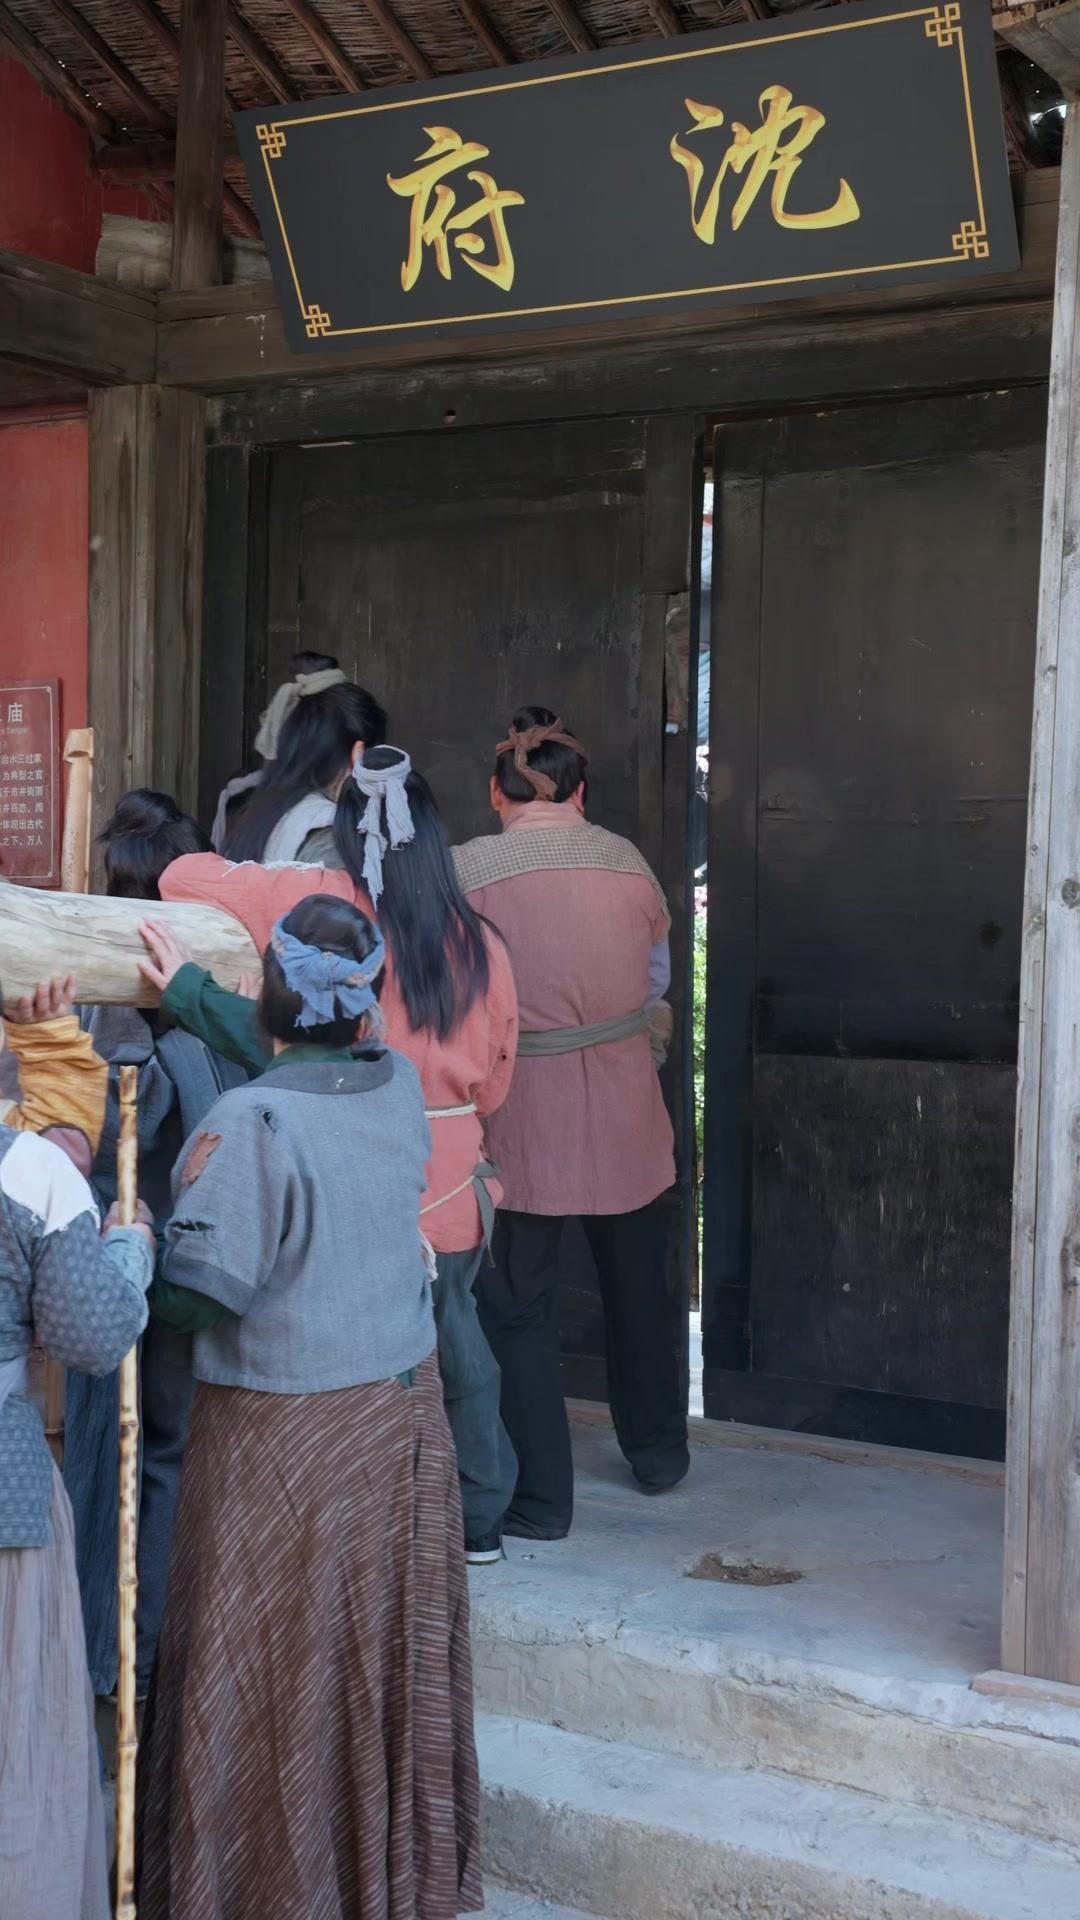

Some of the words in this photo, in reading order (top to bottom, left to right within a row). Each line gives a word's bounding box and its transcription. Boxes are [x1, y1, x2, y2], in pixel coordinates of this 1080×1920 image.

[0, 702, 23, 723] 庙
[0, 819, 43, 830] 体现出古代
[0, 835, 43, 847] 之下、万人
